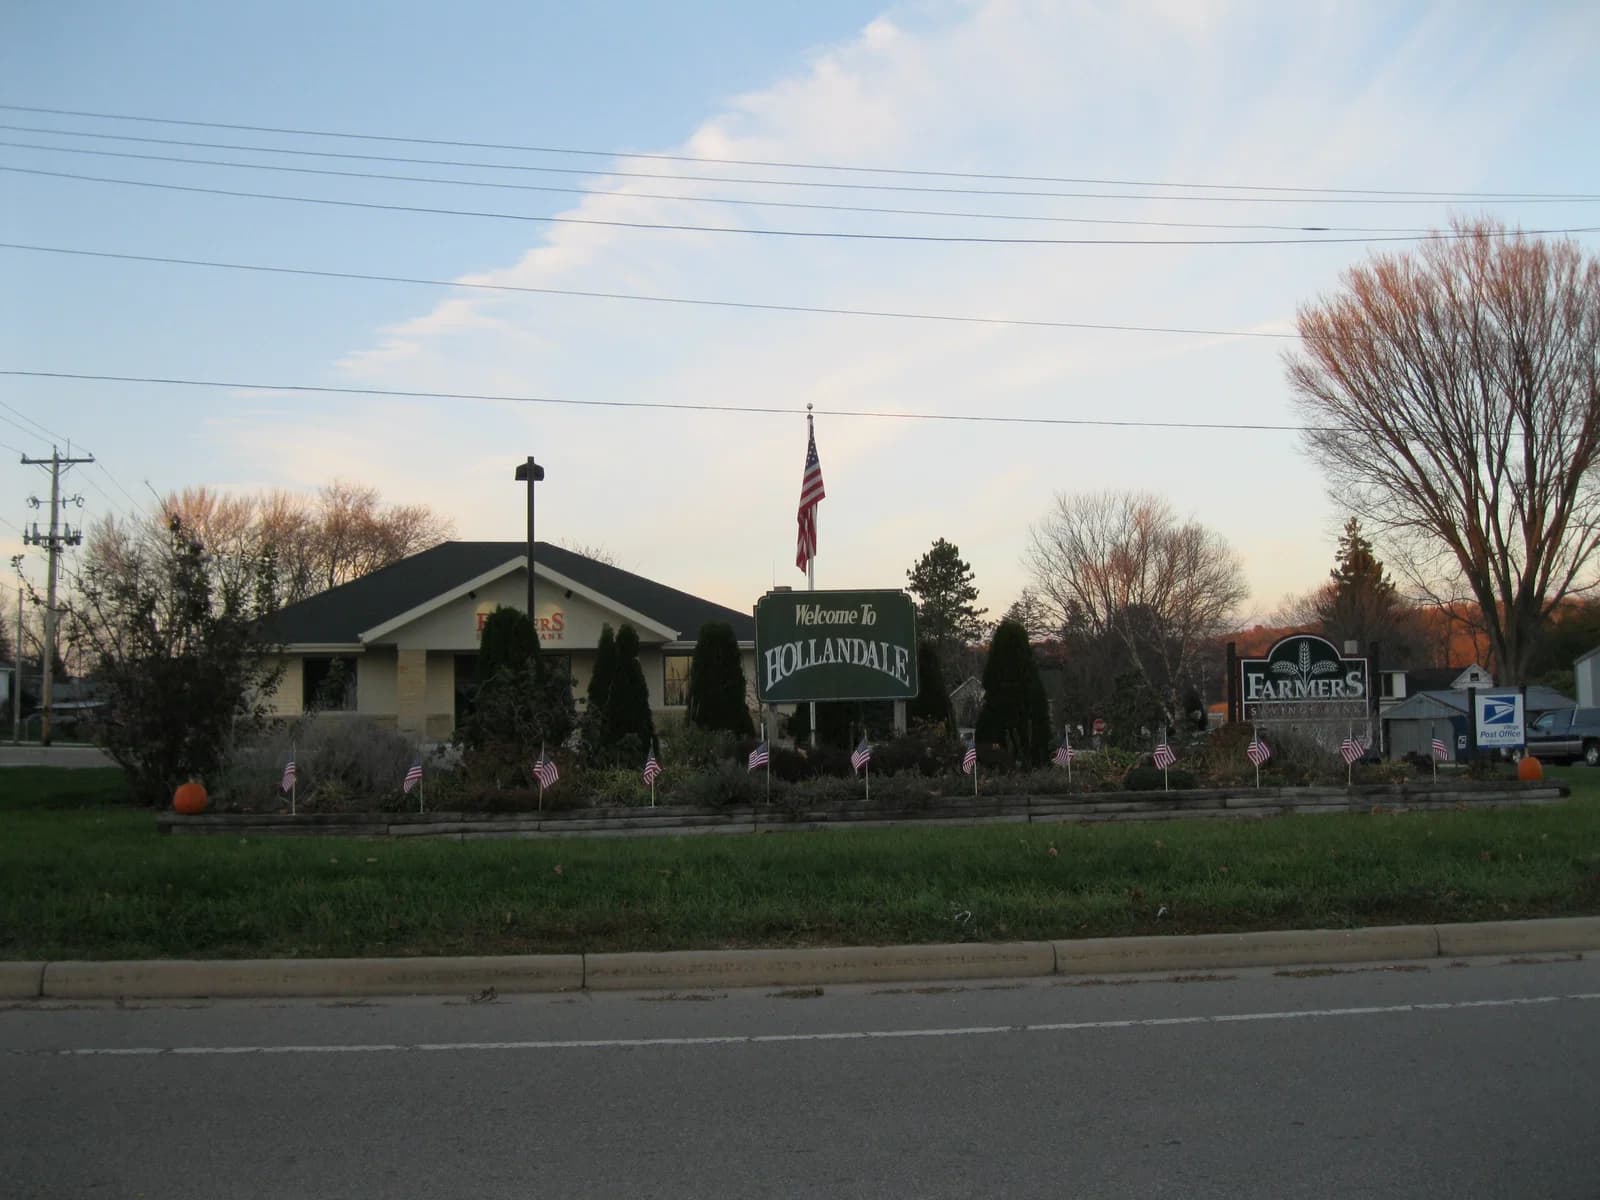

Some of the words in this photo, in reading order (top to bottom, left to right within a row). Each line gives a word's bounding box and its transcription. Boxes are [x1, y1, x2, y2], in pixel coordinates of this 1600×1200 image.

[795, 604, 858, 626] Welcome
[860, 604, 877, 626] To
[764, 638, 910, 692] HOLLANDALE
[1247, 671, 1364, 699] FARMERS
[1480, 730, 1497, 738] Post
[1499, 730, 1520, 738] Office
